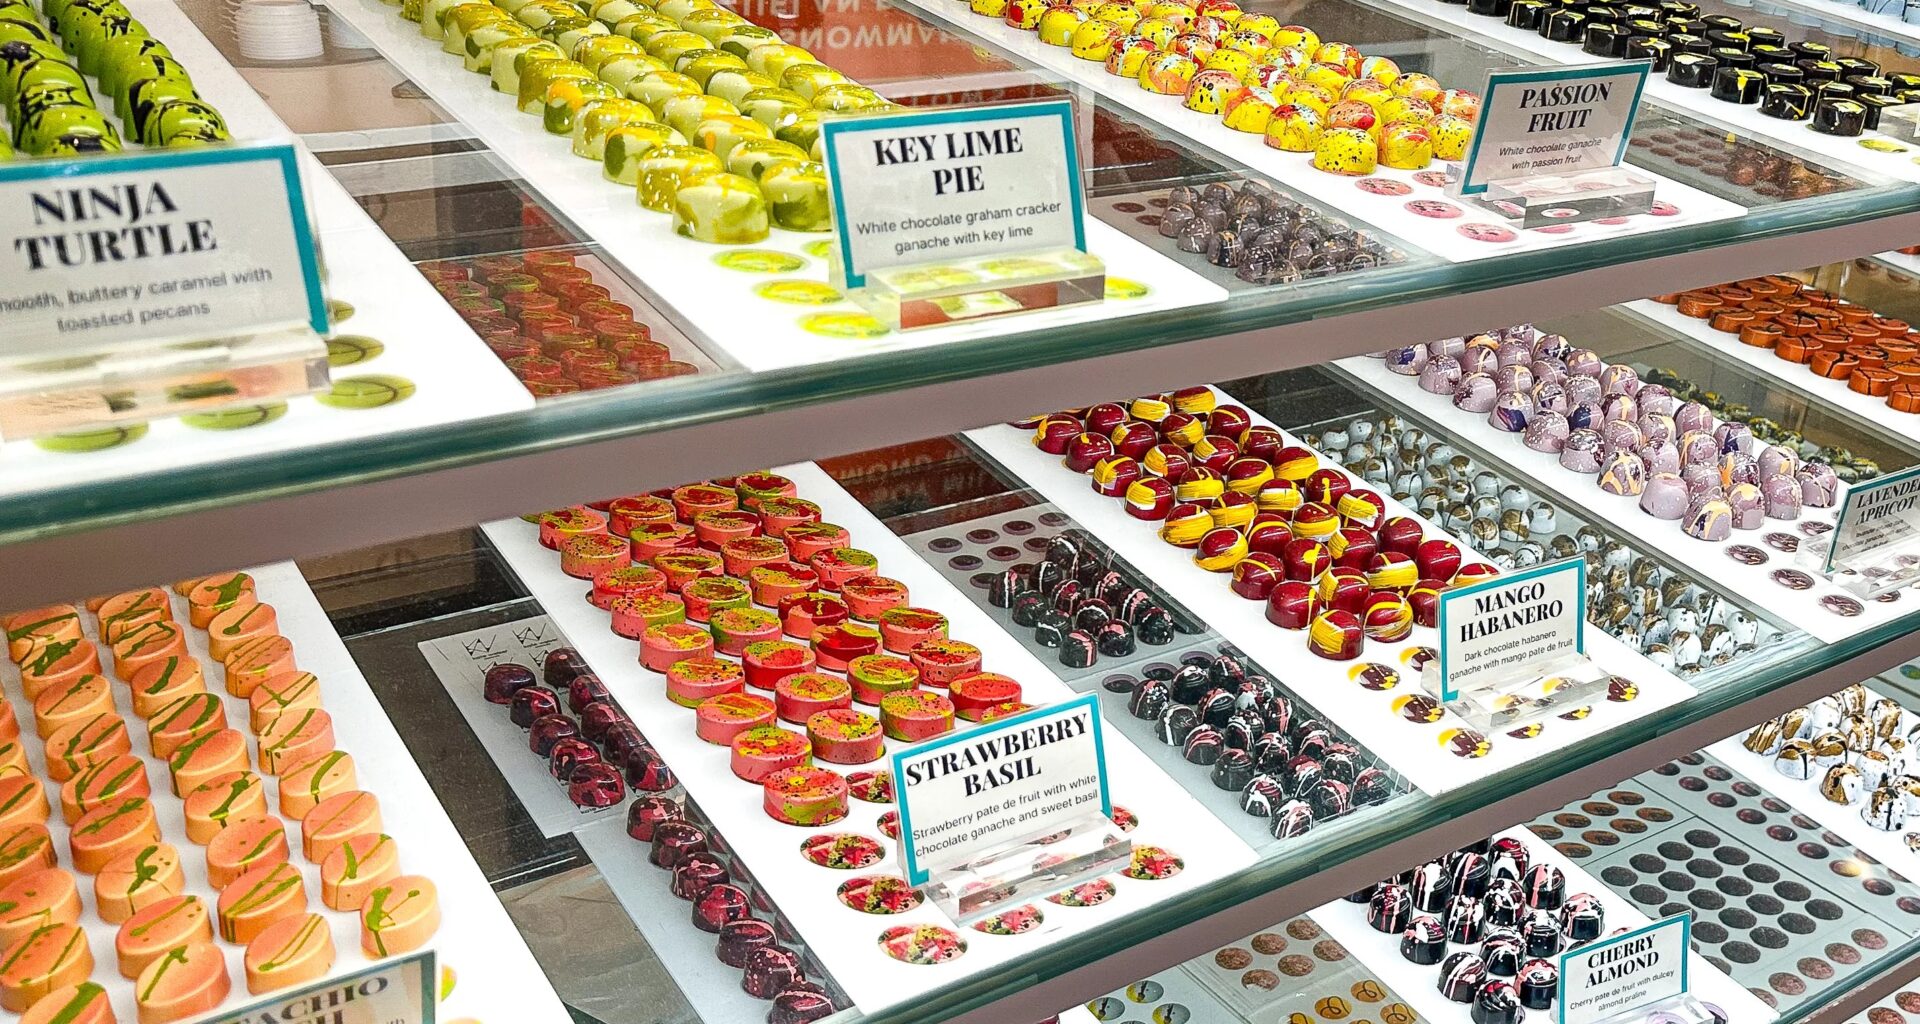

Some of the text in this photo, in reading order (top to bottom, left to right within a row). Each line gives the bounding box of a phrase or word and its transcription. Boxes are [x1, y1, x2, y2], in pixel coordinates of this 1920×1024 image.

[1519, 82, 1612, 108] PASSION
[1527, 109, 1592, 133] FRUIT
[873, 127, 1023, 166] KEY LIME
[1500, 138, 1602, 156] White chocolate ganache
[1512, 155, 1582, 170] with passion fruit
[933, 165, 985, 196] PIE
[30, 181, 179, 225] NINJA
[856, 201, 1062, 235] White chocolate graham cracker
[14, 219, 218, 271] TURTLE
[895, 225, 1033, 256] ganache with key lime
[0, 267, 272, 313] mooth, buttery caramel with
[57, 301, 210, 332] toasted pecans
[1855, 495, 1918, 526] APRICOT
[1475, 582, 1545, 616] MANGO
[1460, 600, 1563, 643] HABANERO
[1449, 638, 1573, 681] ganache with mango pate de fruit
[1464, 630, 1557, 662] Dark chocolate habanero
[906, 713, 1087, 787] STRAWBERRY
[963, 756, 1042, 798] BASIL
[913, 774, 1097, 841] Strawberry pate de fruit with white
[915, 790, 1098, 857] chocolate ganache and sweet basil
[1588, 934, 1656, 968] CHERRY
[1585, 952, 1659, 988] ALMOND
[229, 977, 388, 1024] ACHIO
[1570, 997, 1593, 1010] Cherry
[1611, 988, 1620, 996] de
[1622, 983, 1635, 992] fruit
[1637, 977, 1651, 987] with
[1653, 969, 1675, 981] dulcey
[1598, 990, 1647, 1011] almond praline
